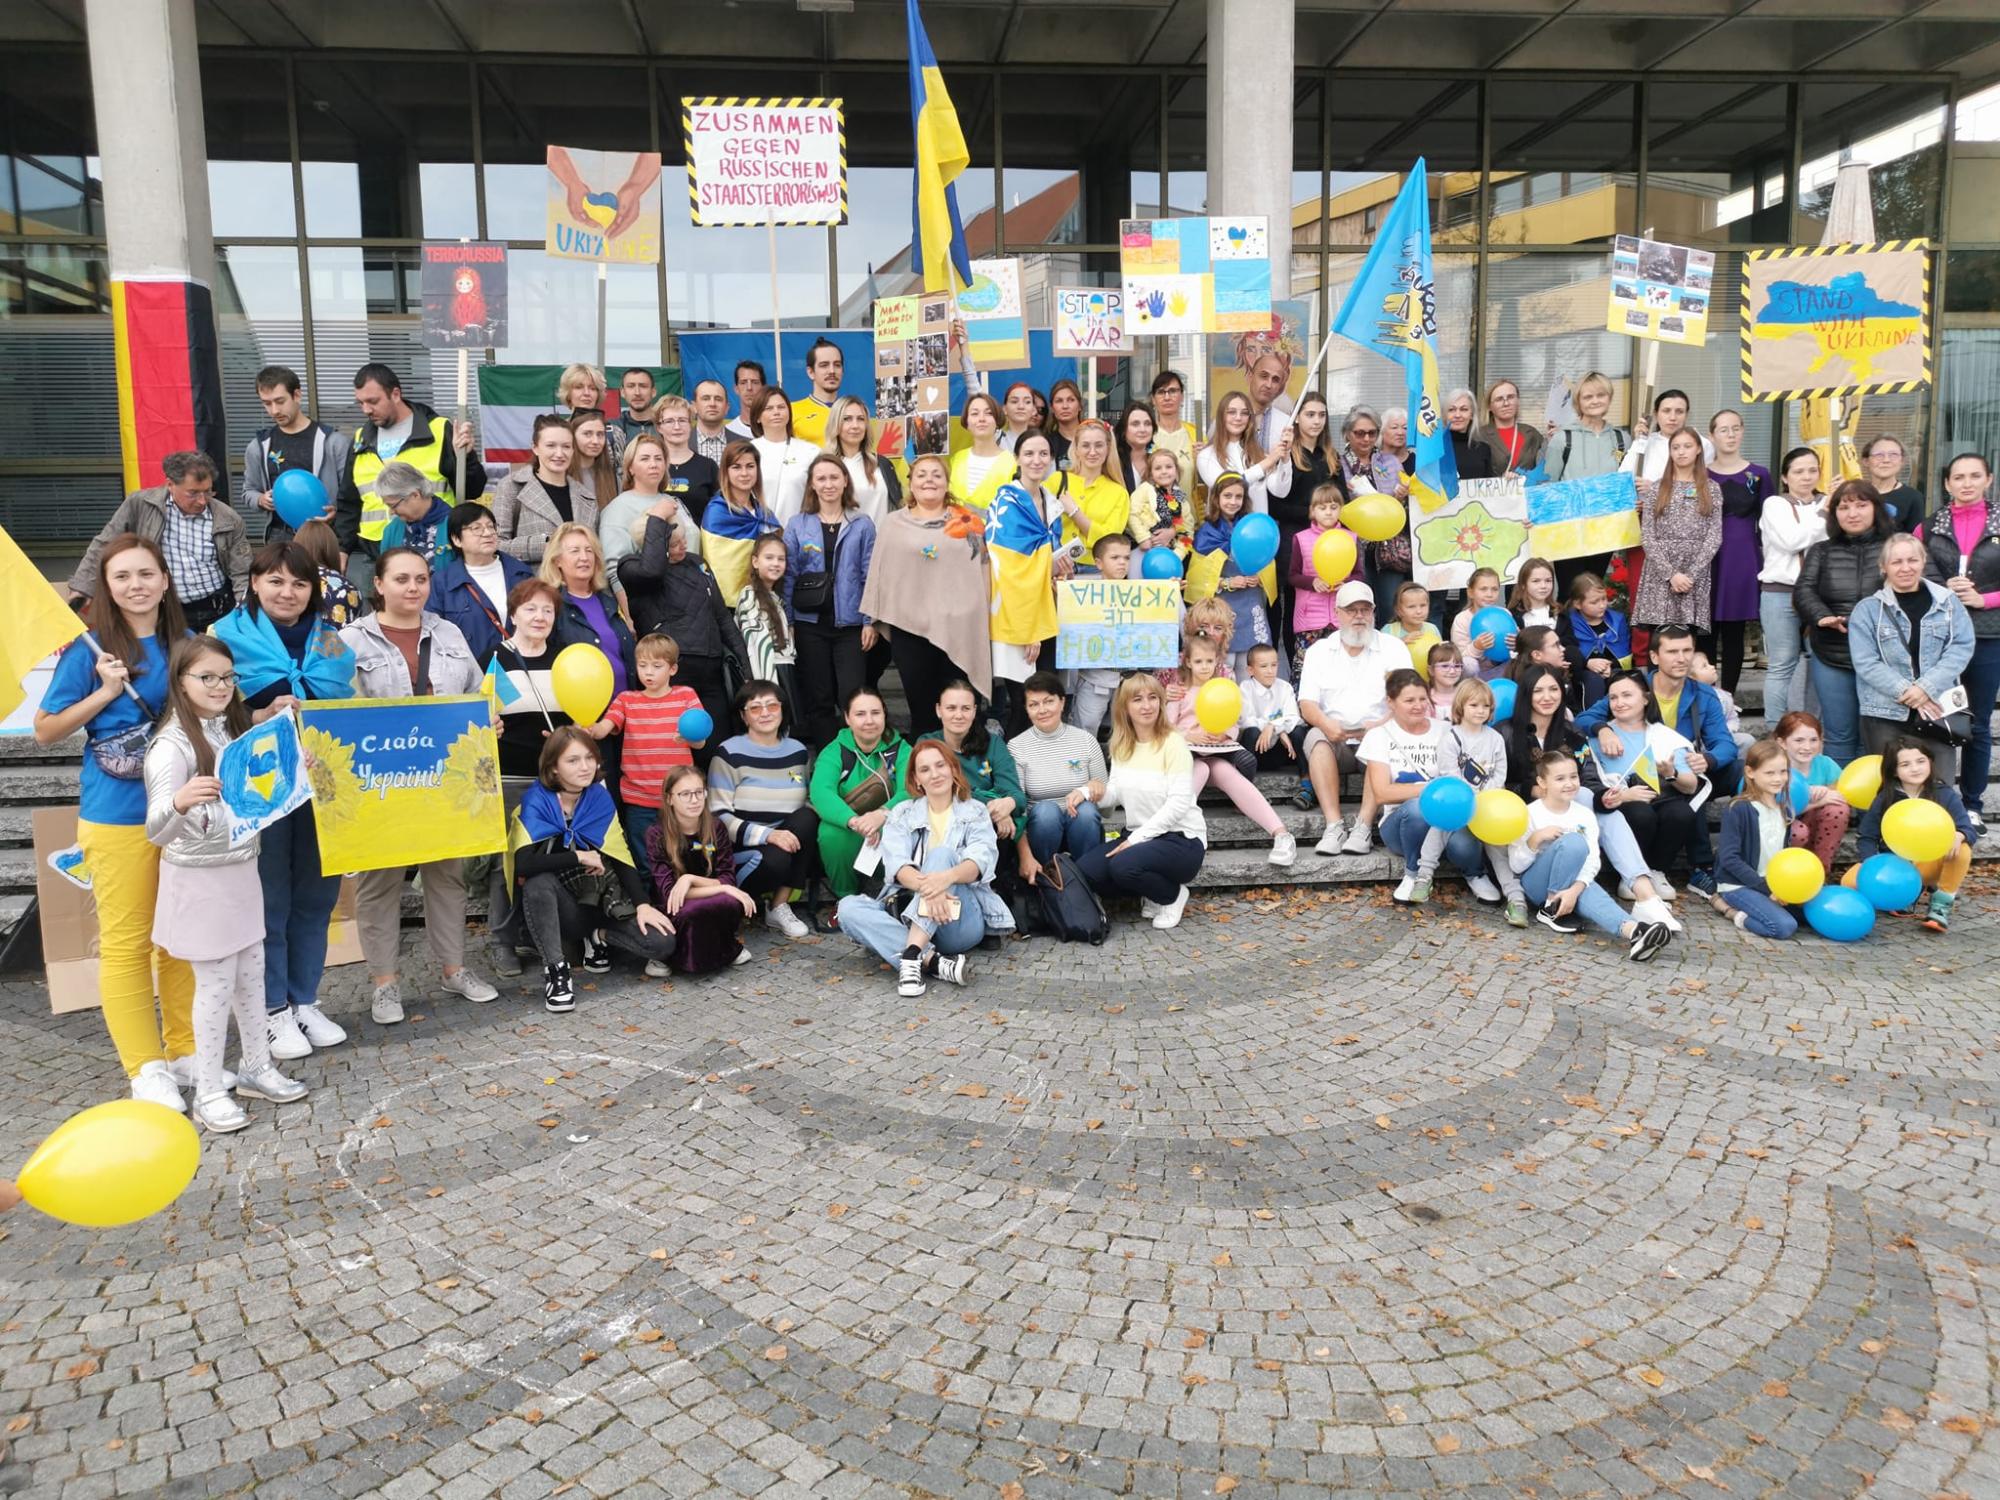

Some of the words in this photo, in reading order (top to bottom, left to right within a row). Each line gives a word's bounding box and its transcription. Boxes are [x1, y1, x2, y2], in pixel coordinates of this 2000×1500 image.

[695, 112, 834, 135] ZUSAMMEN
[723, 138, 800, 157] GEGEN
[719, 158, 828, 179] RUSSISCHEN
[1065, 294, 1121, 314] STOP
[1777, 288, 1854, 315] STAND
[1810, 312, 1866, 332] WITH
[1069, 326, 1121, 348] WAR
[1069, 583, 1175, 608] УКРАЇНА
[361, 726, 436, 753] Слава
[358, 758, 443, 800] Україні!
